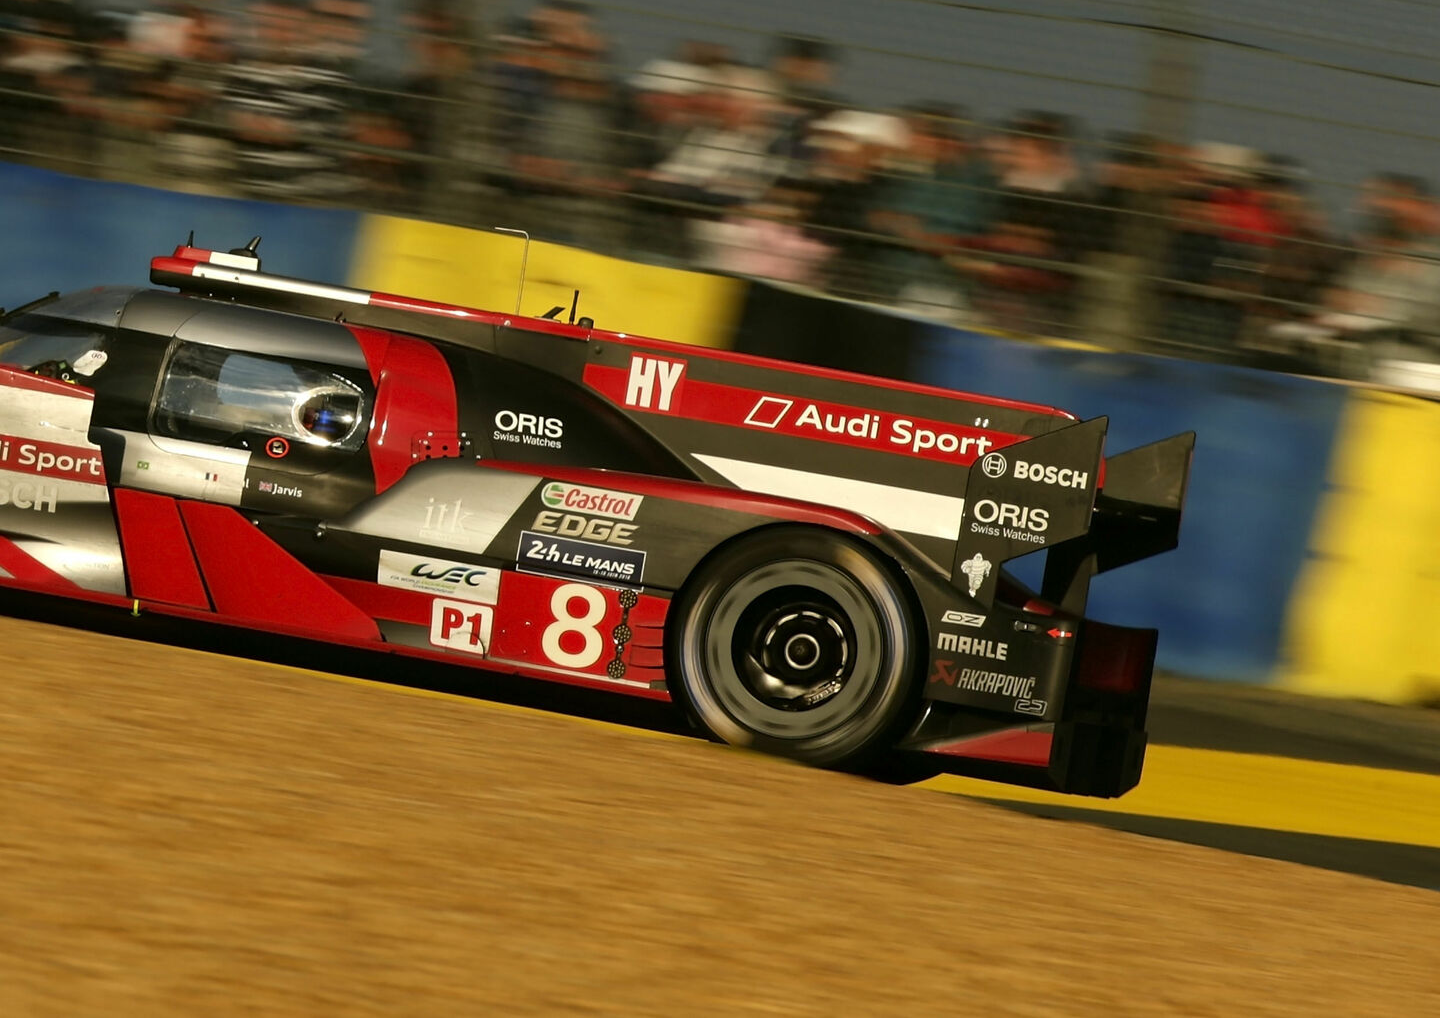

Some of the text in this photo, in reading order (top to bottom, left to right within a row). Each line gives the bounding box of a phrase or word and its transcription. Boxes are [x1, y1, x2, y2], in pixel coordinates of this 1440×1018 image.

[624, 356, 685, 412] HY
[494, 410, 563, 438] ORIS
[795, 404, 993, 457] Audi Sport
[493, 430, 562, 449] Swiss Watches
[17, 444, 101, 476] Sport
[1013, 460, 1088, 490] BOSCH
[272, 483, 302, 498] Jarvis
[564, 488, 634, 516] Castrol
[531, 511, 640, 545] EDGE
[973, 499, 1050, 532] ORIS
[970, 522, 1046, 544] Swiss Watches
[410, 563, 487, 587] WEC
[561, 553, 585, 567] LE
[585, 557, 635, 575] MANS
[441, 606, 482, 646] P1
[542, 583, 607, 669] 8
[936, 632, 1009, 661] MAHLE
